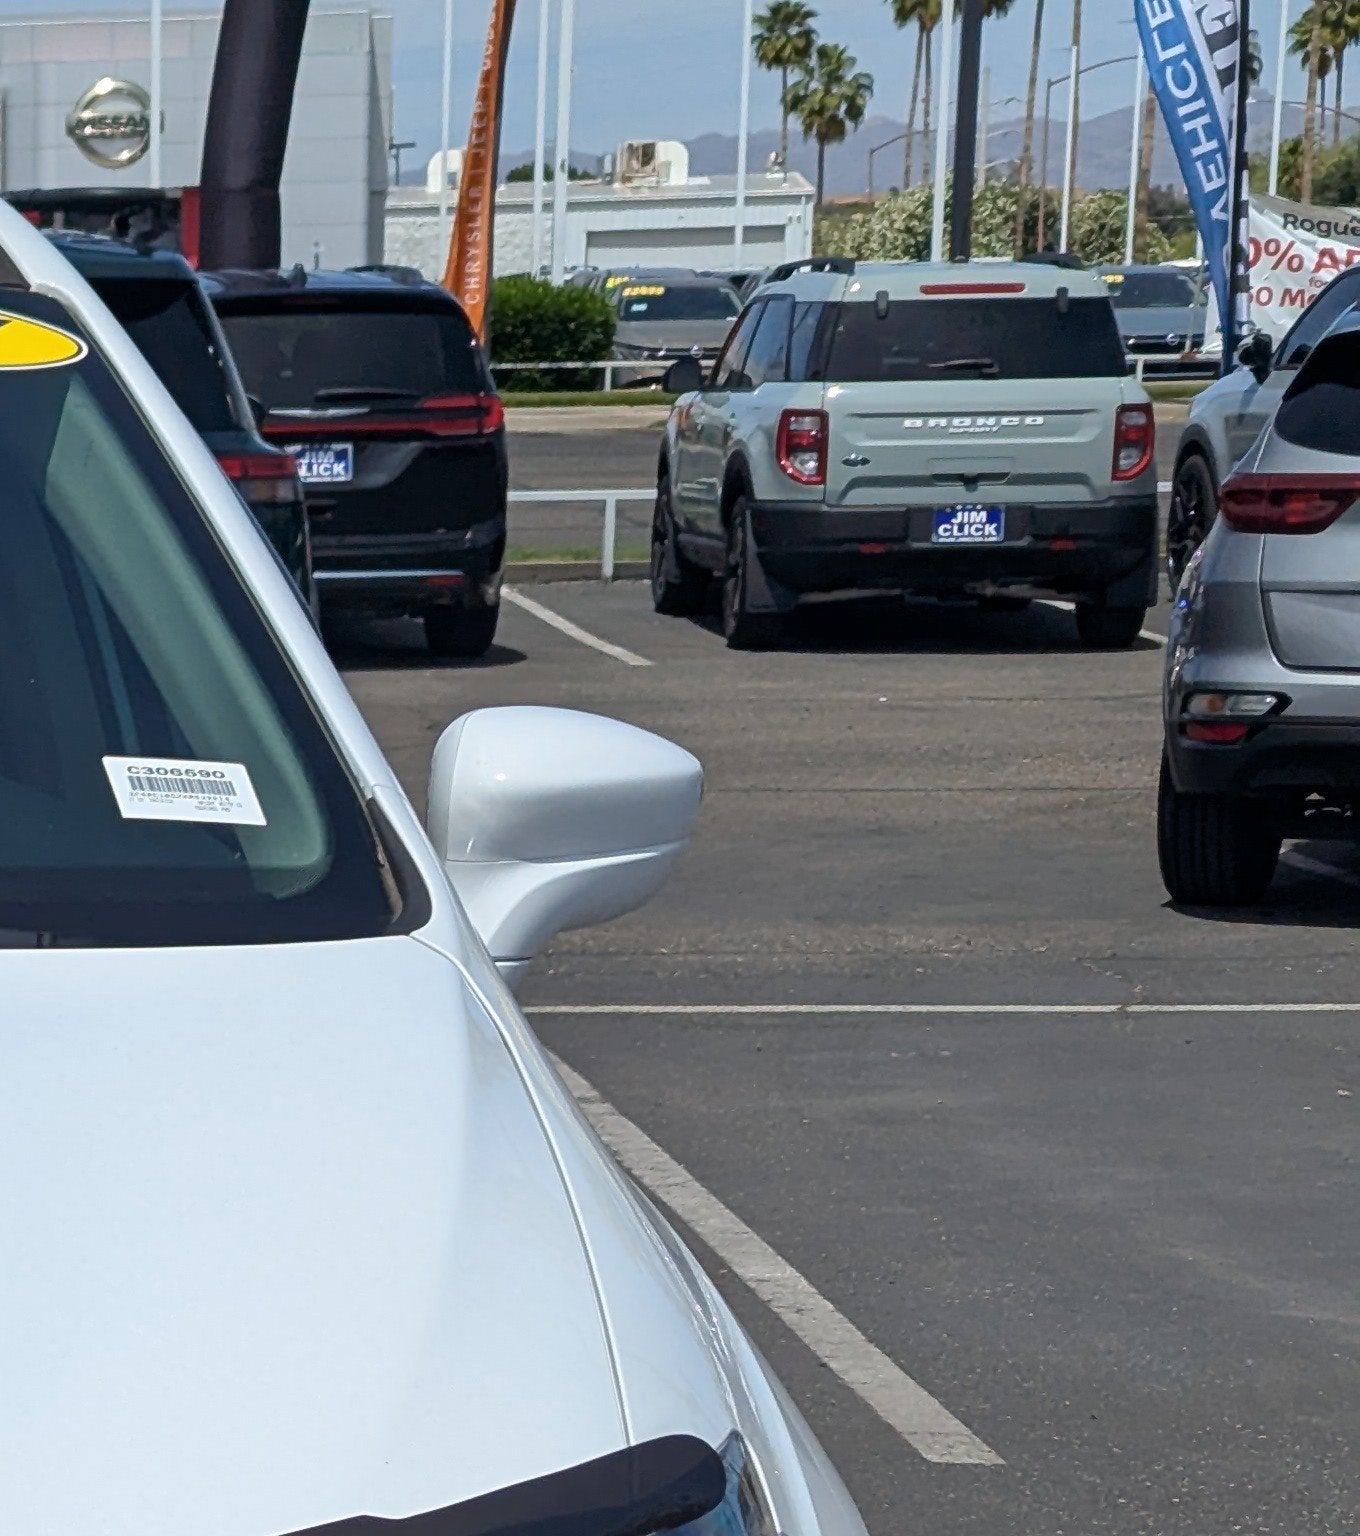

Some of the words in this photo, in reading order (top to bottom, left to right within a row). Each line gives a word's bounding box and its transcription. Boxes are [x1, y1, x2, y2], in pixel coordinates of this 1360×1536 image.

[464, 186, 482, 304] CHRYSLER
[903, 415, 1045, 428] BRONCO
[304, 450, 335, 463] JIM
[297, 462, 346, 476] LICK
[951, 510, 988, 523] JIM
[937, 523, 998, 537] CLICK
